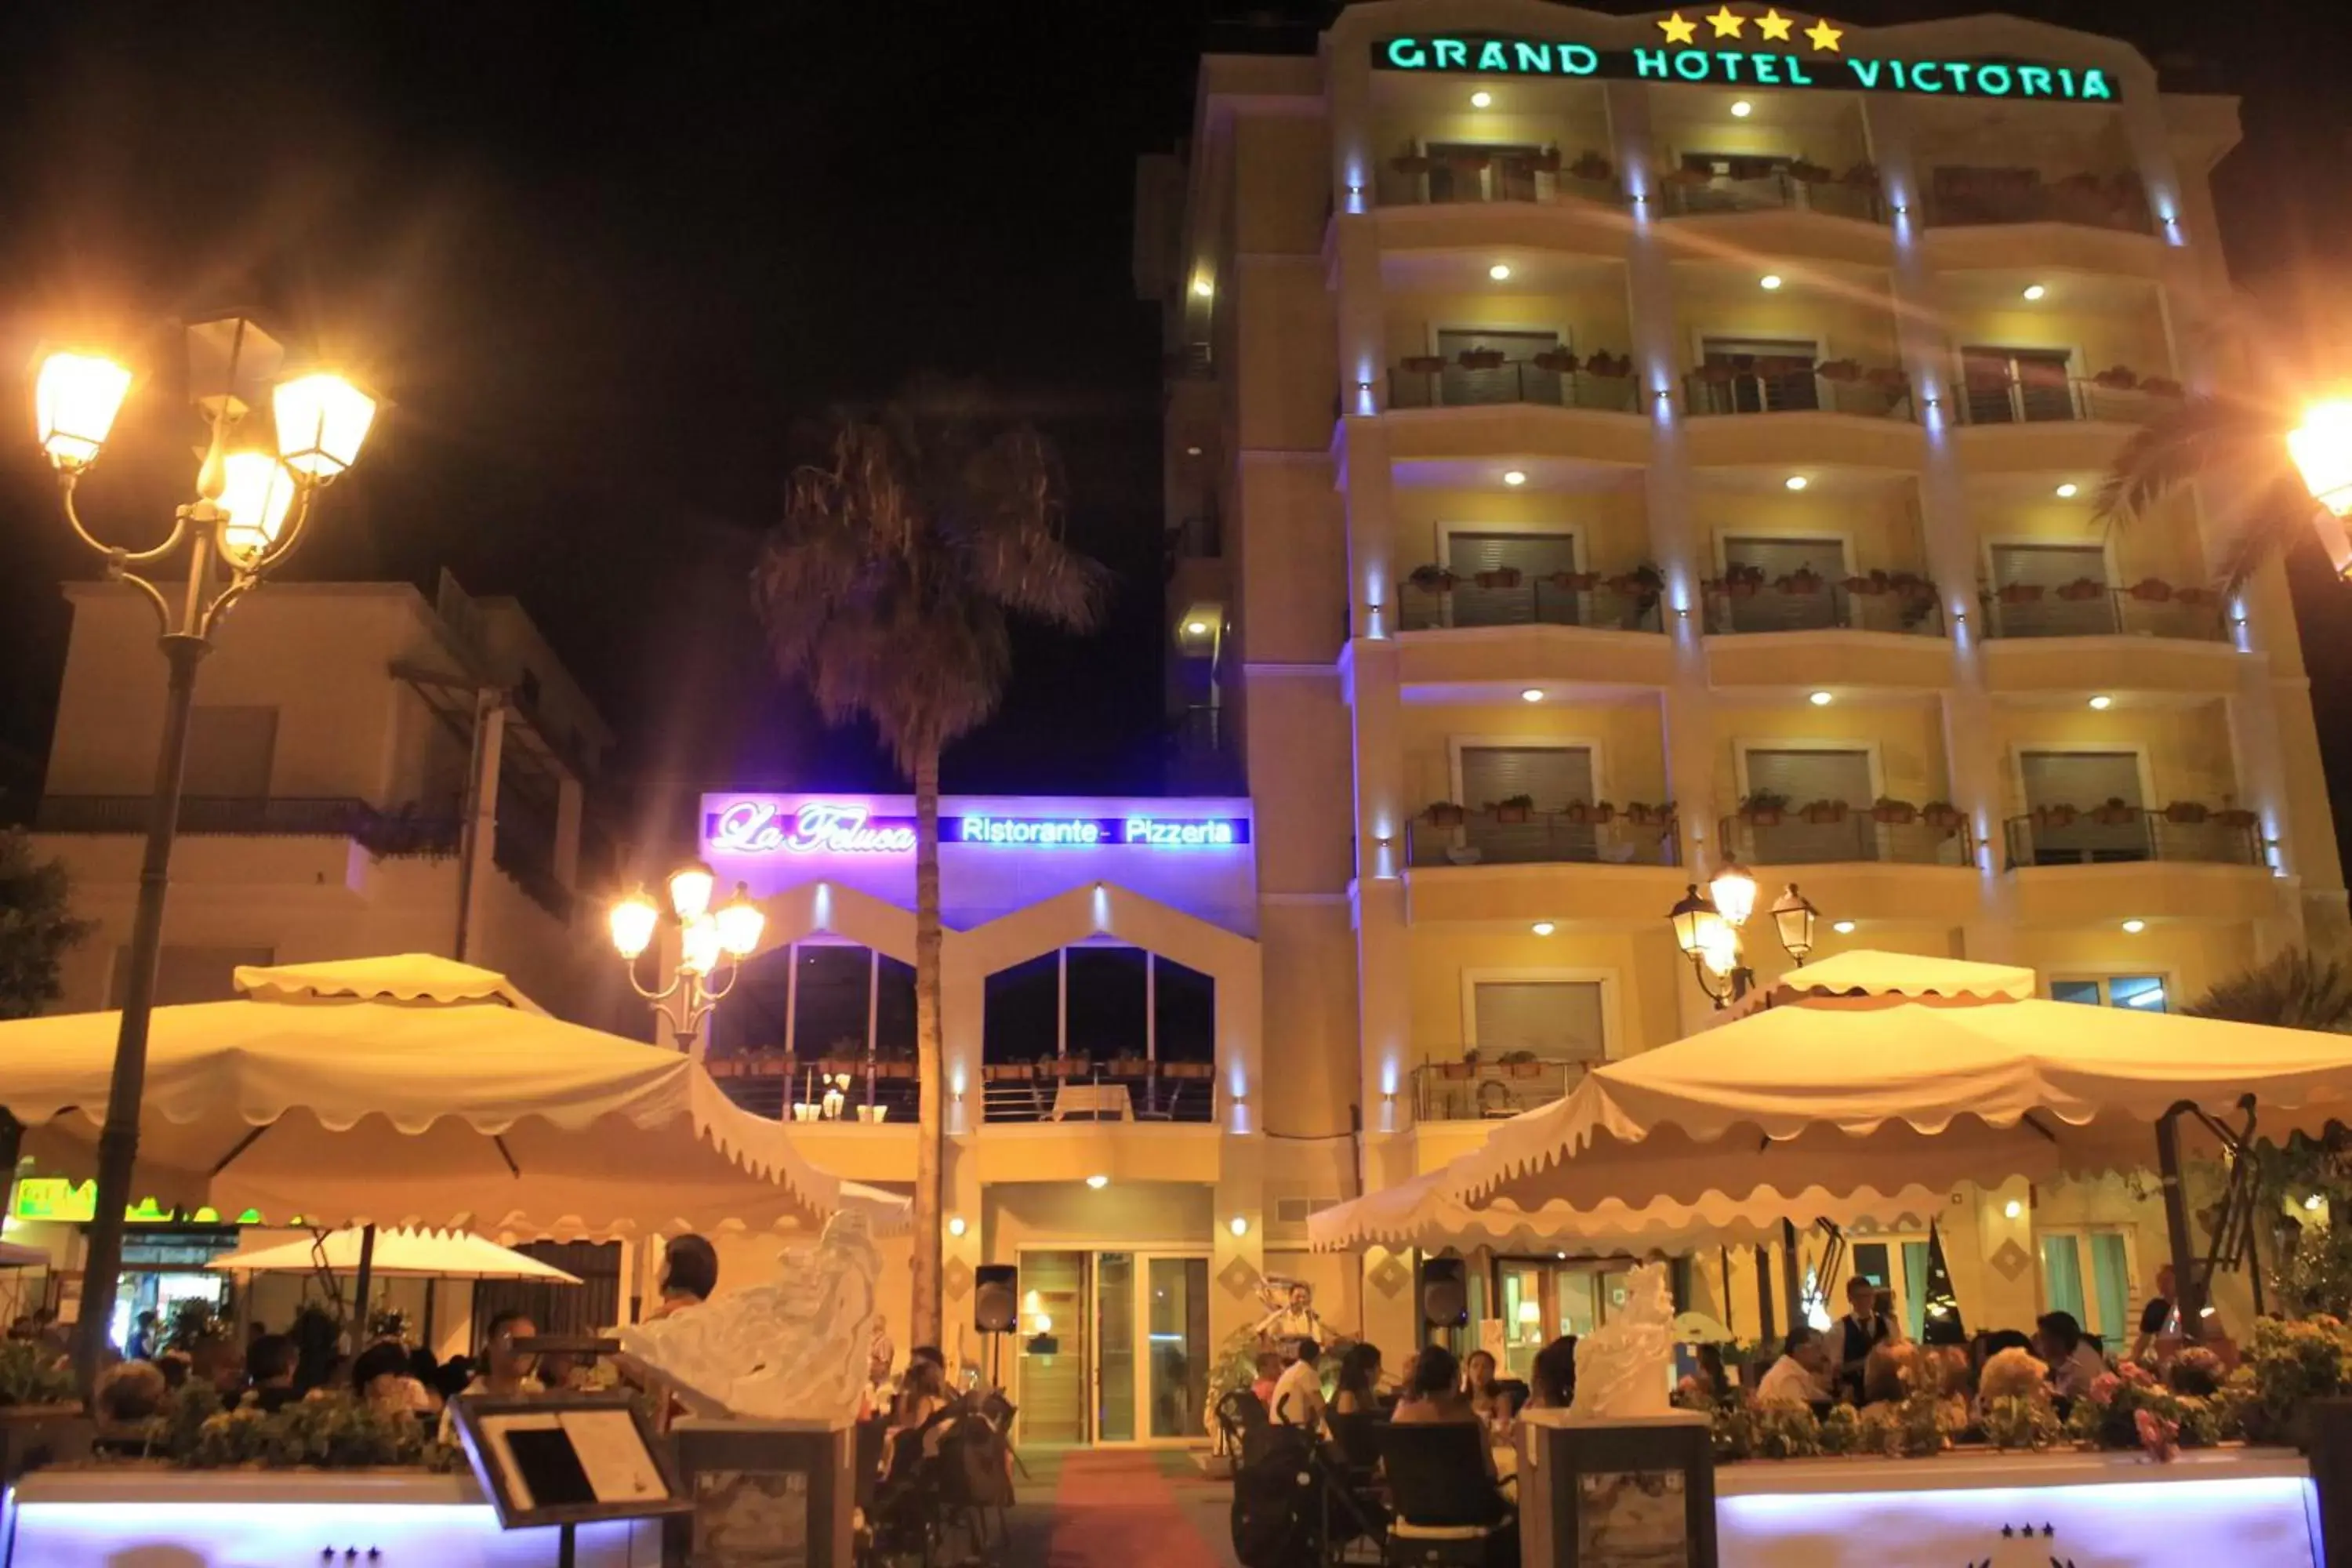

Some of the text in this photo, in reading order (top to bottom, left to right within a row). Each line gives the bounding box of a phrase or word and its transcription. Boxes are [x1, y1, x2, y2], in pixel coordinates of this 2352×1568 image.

[1388, 38, 2111, 99] GRAND HOTEL VICTORIA
[711, 801, 782, 851] La
[1126, 818, 1232, 844] Pizzeria
